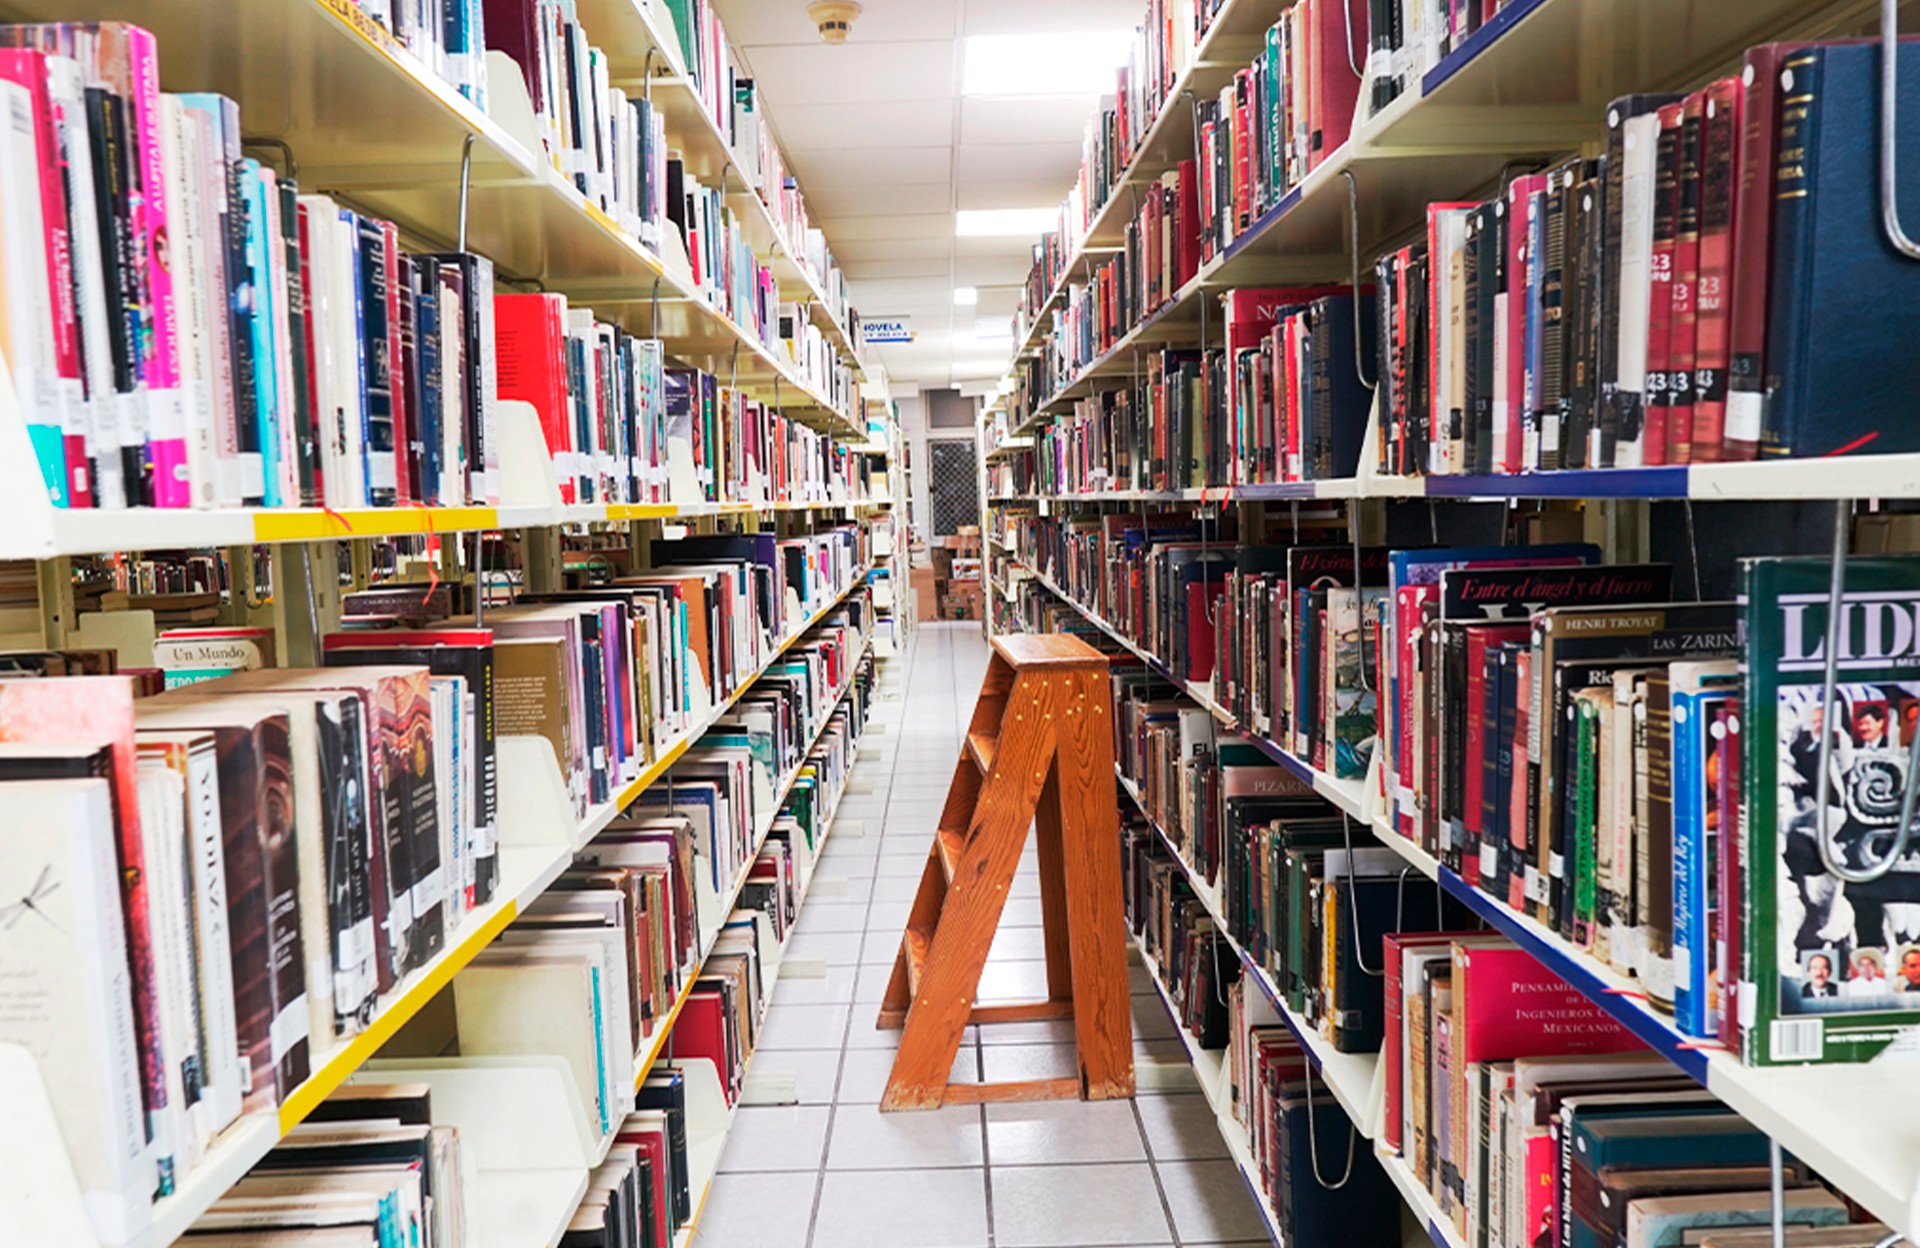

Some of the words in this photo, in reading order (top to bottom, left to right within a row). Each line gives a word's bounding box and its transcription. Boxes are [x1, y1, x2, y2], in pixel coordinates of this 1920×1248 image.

[1461, 578, 1508, 599] Entre
[1512, 578, 1531, 598] el
[1588, 576, 1606, 597] el
[1565, 618, 1607, 631] HENRI
[1610, 616, 1658, 629] TROYAT
[1778, 601, 1920, 662] LID
[1653, 638, 1676, 650] LAS
[1681, 633, 1741, 650] ZARIN
[173, 648, 193, 661] Un
[198, 646, 246, 660] Mundo
[484, 755, 495, 824] SICÓLOGA
[1674, 885, 1693, 933] Mujeres
[1516, 1009, 1594, 1020] INGENIEROS
[1543, 1022, 1621, 1034] MEXICANOS
[1562, 1188, 1572, 1223] hijos
[1562, 1223, 1571, 1248] Los
